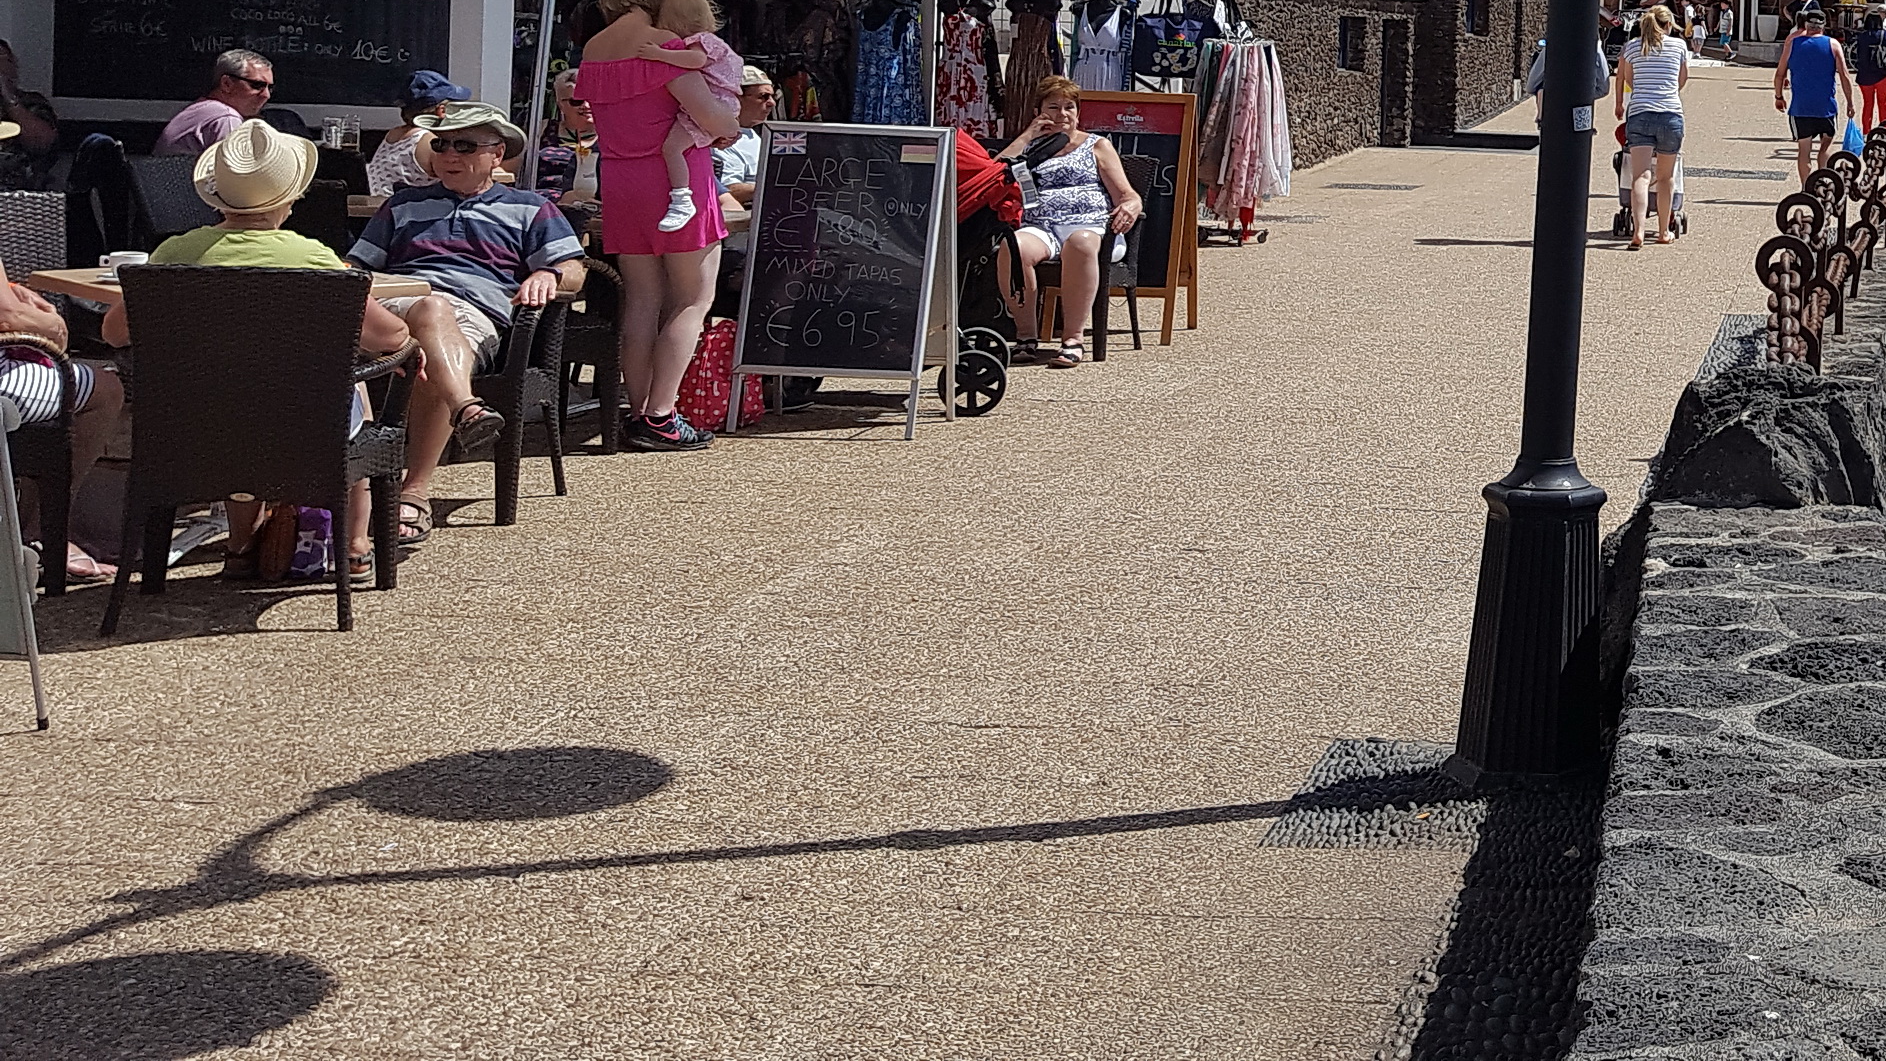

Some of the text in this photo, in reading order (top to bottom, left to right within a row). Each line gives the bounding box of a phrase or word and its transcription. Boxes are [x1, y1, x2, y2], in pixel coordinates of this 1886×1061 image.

[350, 38, 393, 64] 10€
[774, 157, 893, 190] LARGE
[789, 187, 928, 218] BEER ONLY
[765, 256, 903, 286] MIXED TAPAS
[785, 281, 851, 305] ONLY
